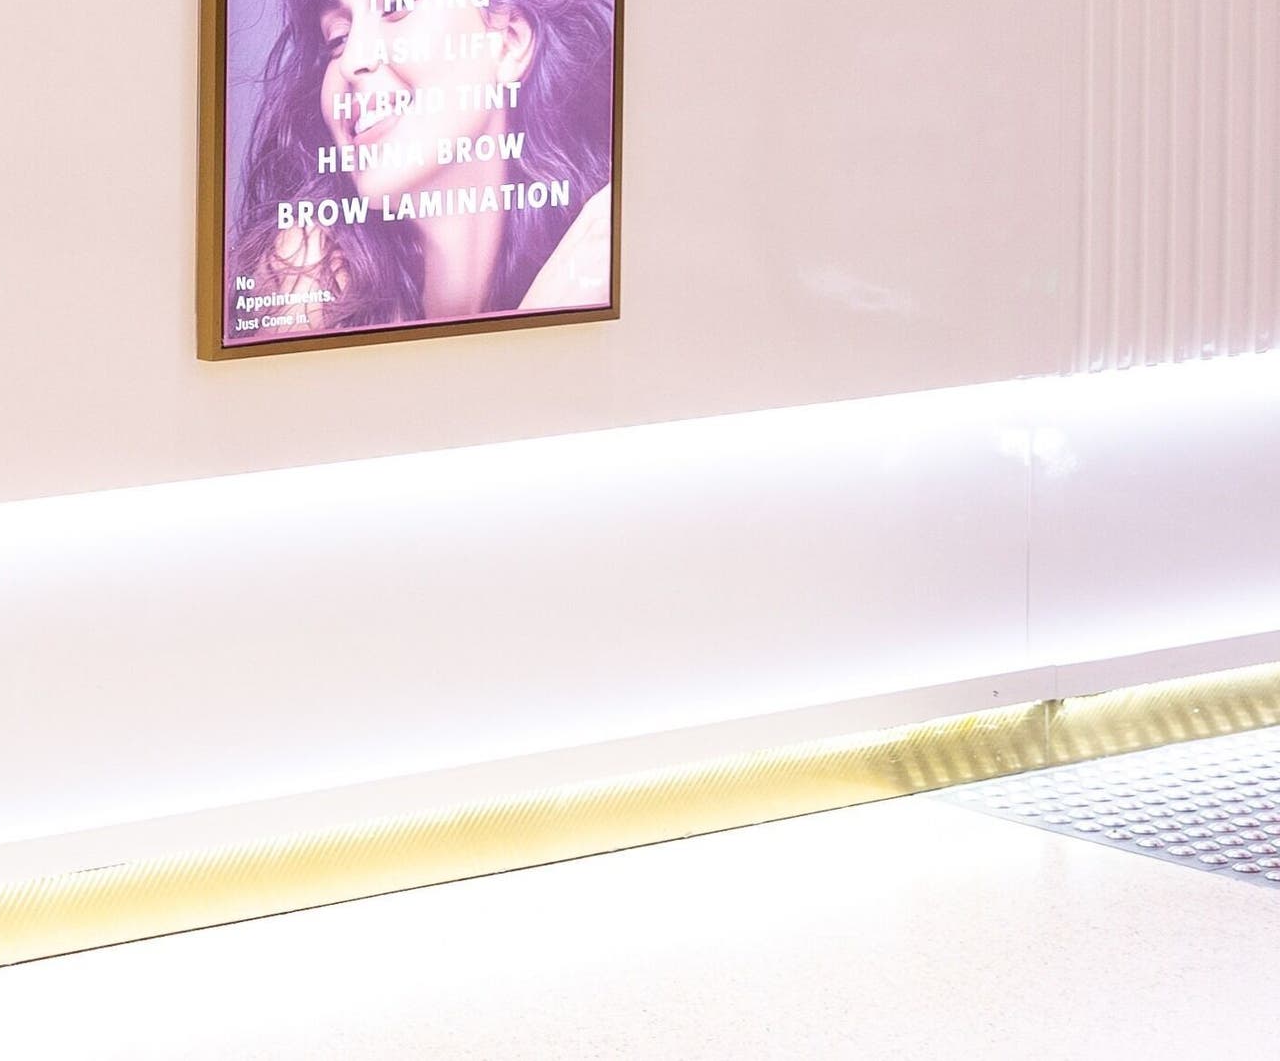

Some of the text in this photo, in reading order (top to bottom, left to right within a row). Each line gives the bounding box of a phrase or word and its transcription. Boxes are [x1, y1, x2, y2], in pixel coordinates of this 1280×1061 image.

[444, 32, 504, 61] LIFT
[333, 81, 522, 121] HYBRID TINT
[317, 132, 526, 174] HENNA BROW
[277, 180, 570, 230] BROW LAMINATION
[236, 276, 255, 291] No
[236, 289, 336, 312] Appointments.
[235, 318, 259, 331] Just
[261, 315, 293, 328] Come
